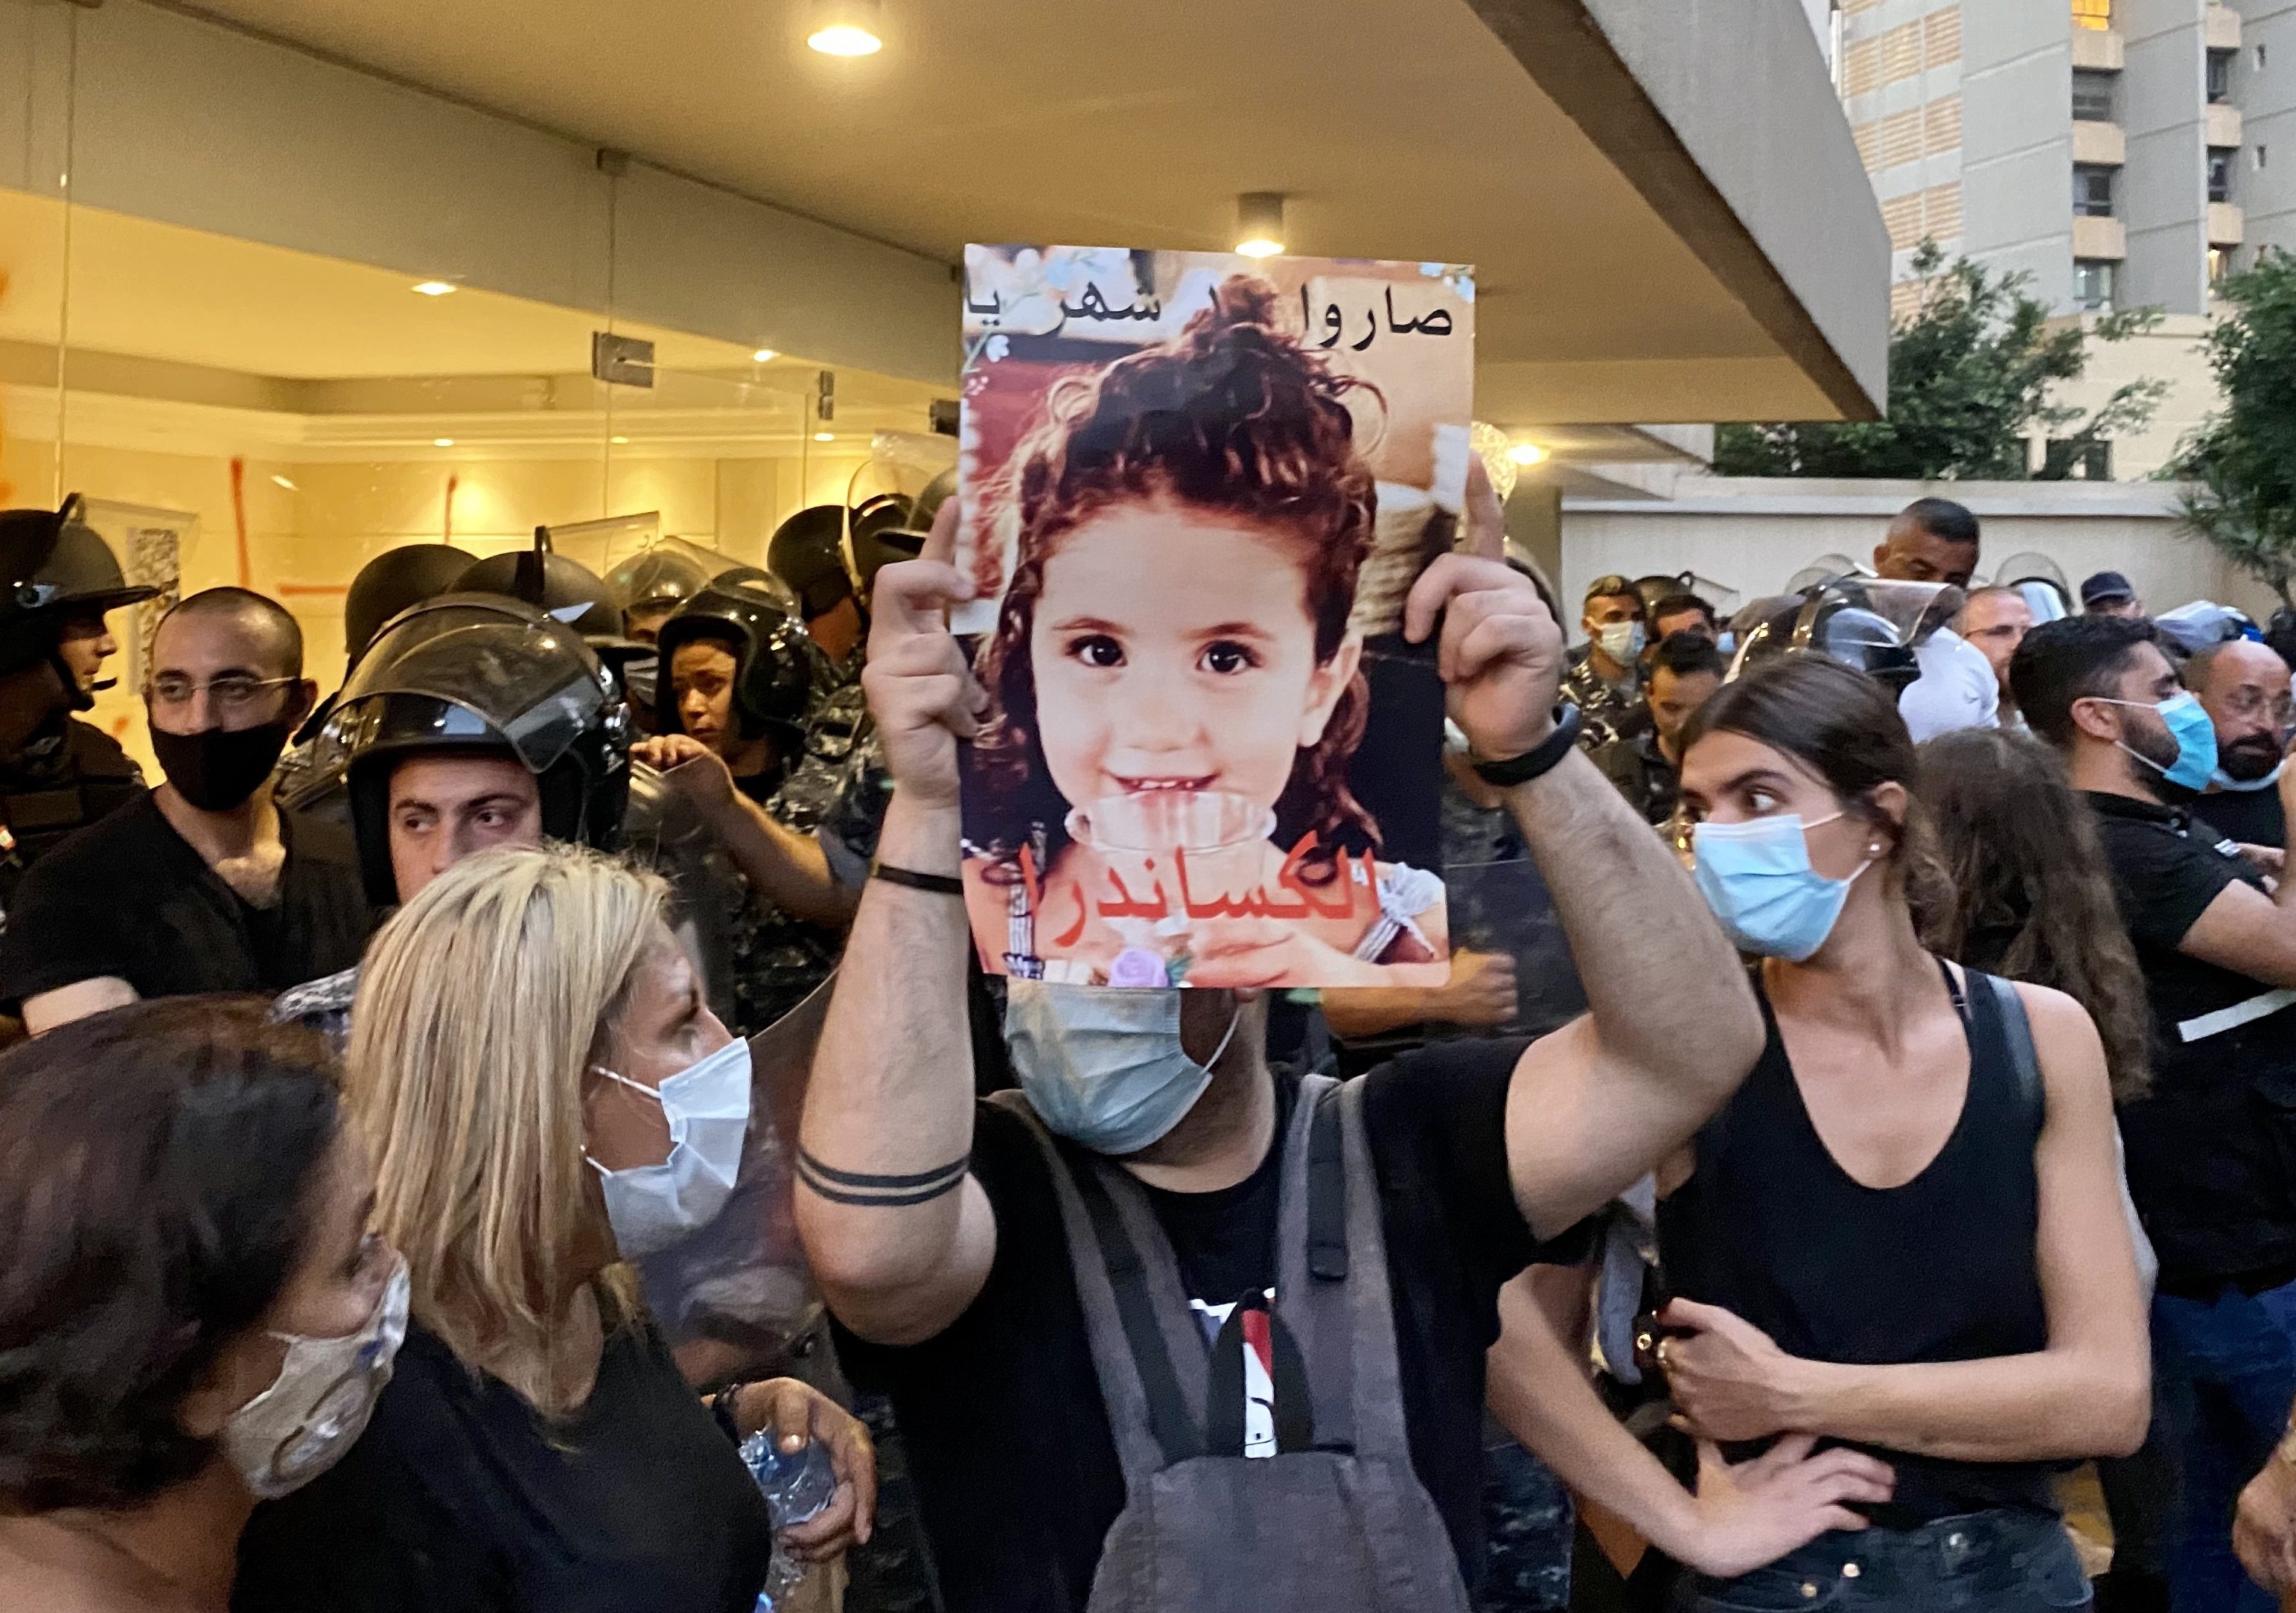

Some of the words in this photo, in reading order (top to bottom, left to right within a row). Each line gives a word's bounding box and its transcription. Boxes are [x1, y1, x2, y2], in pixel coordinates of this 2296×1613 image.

[966, 269, 1000, 327] يا
[1042, 281, 1161, 339] شهر
[1300, 282, 1452, 352] صاروا
[1018, 830, 1383, 948] الكساندرا
